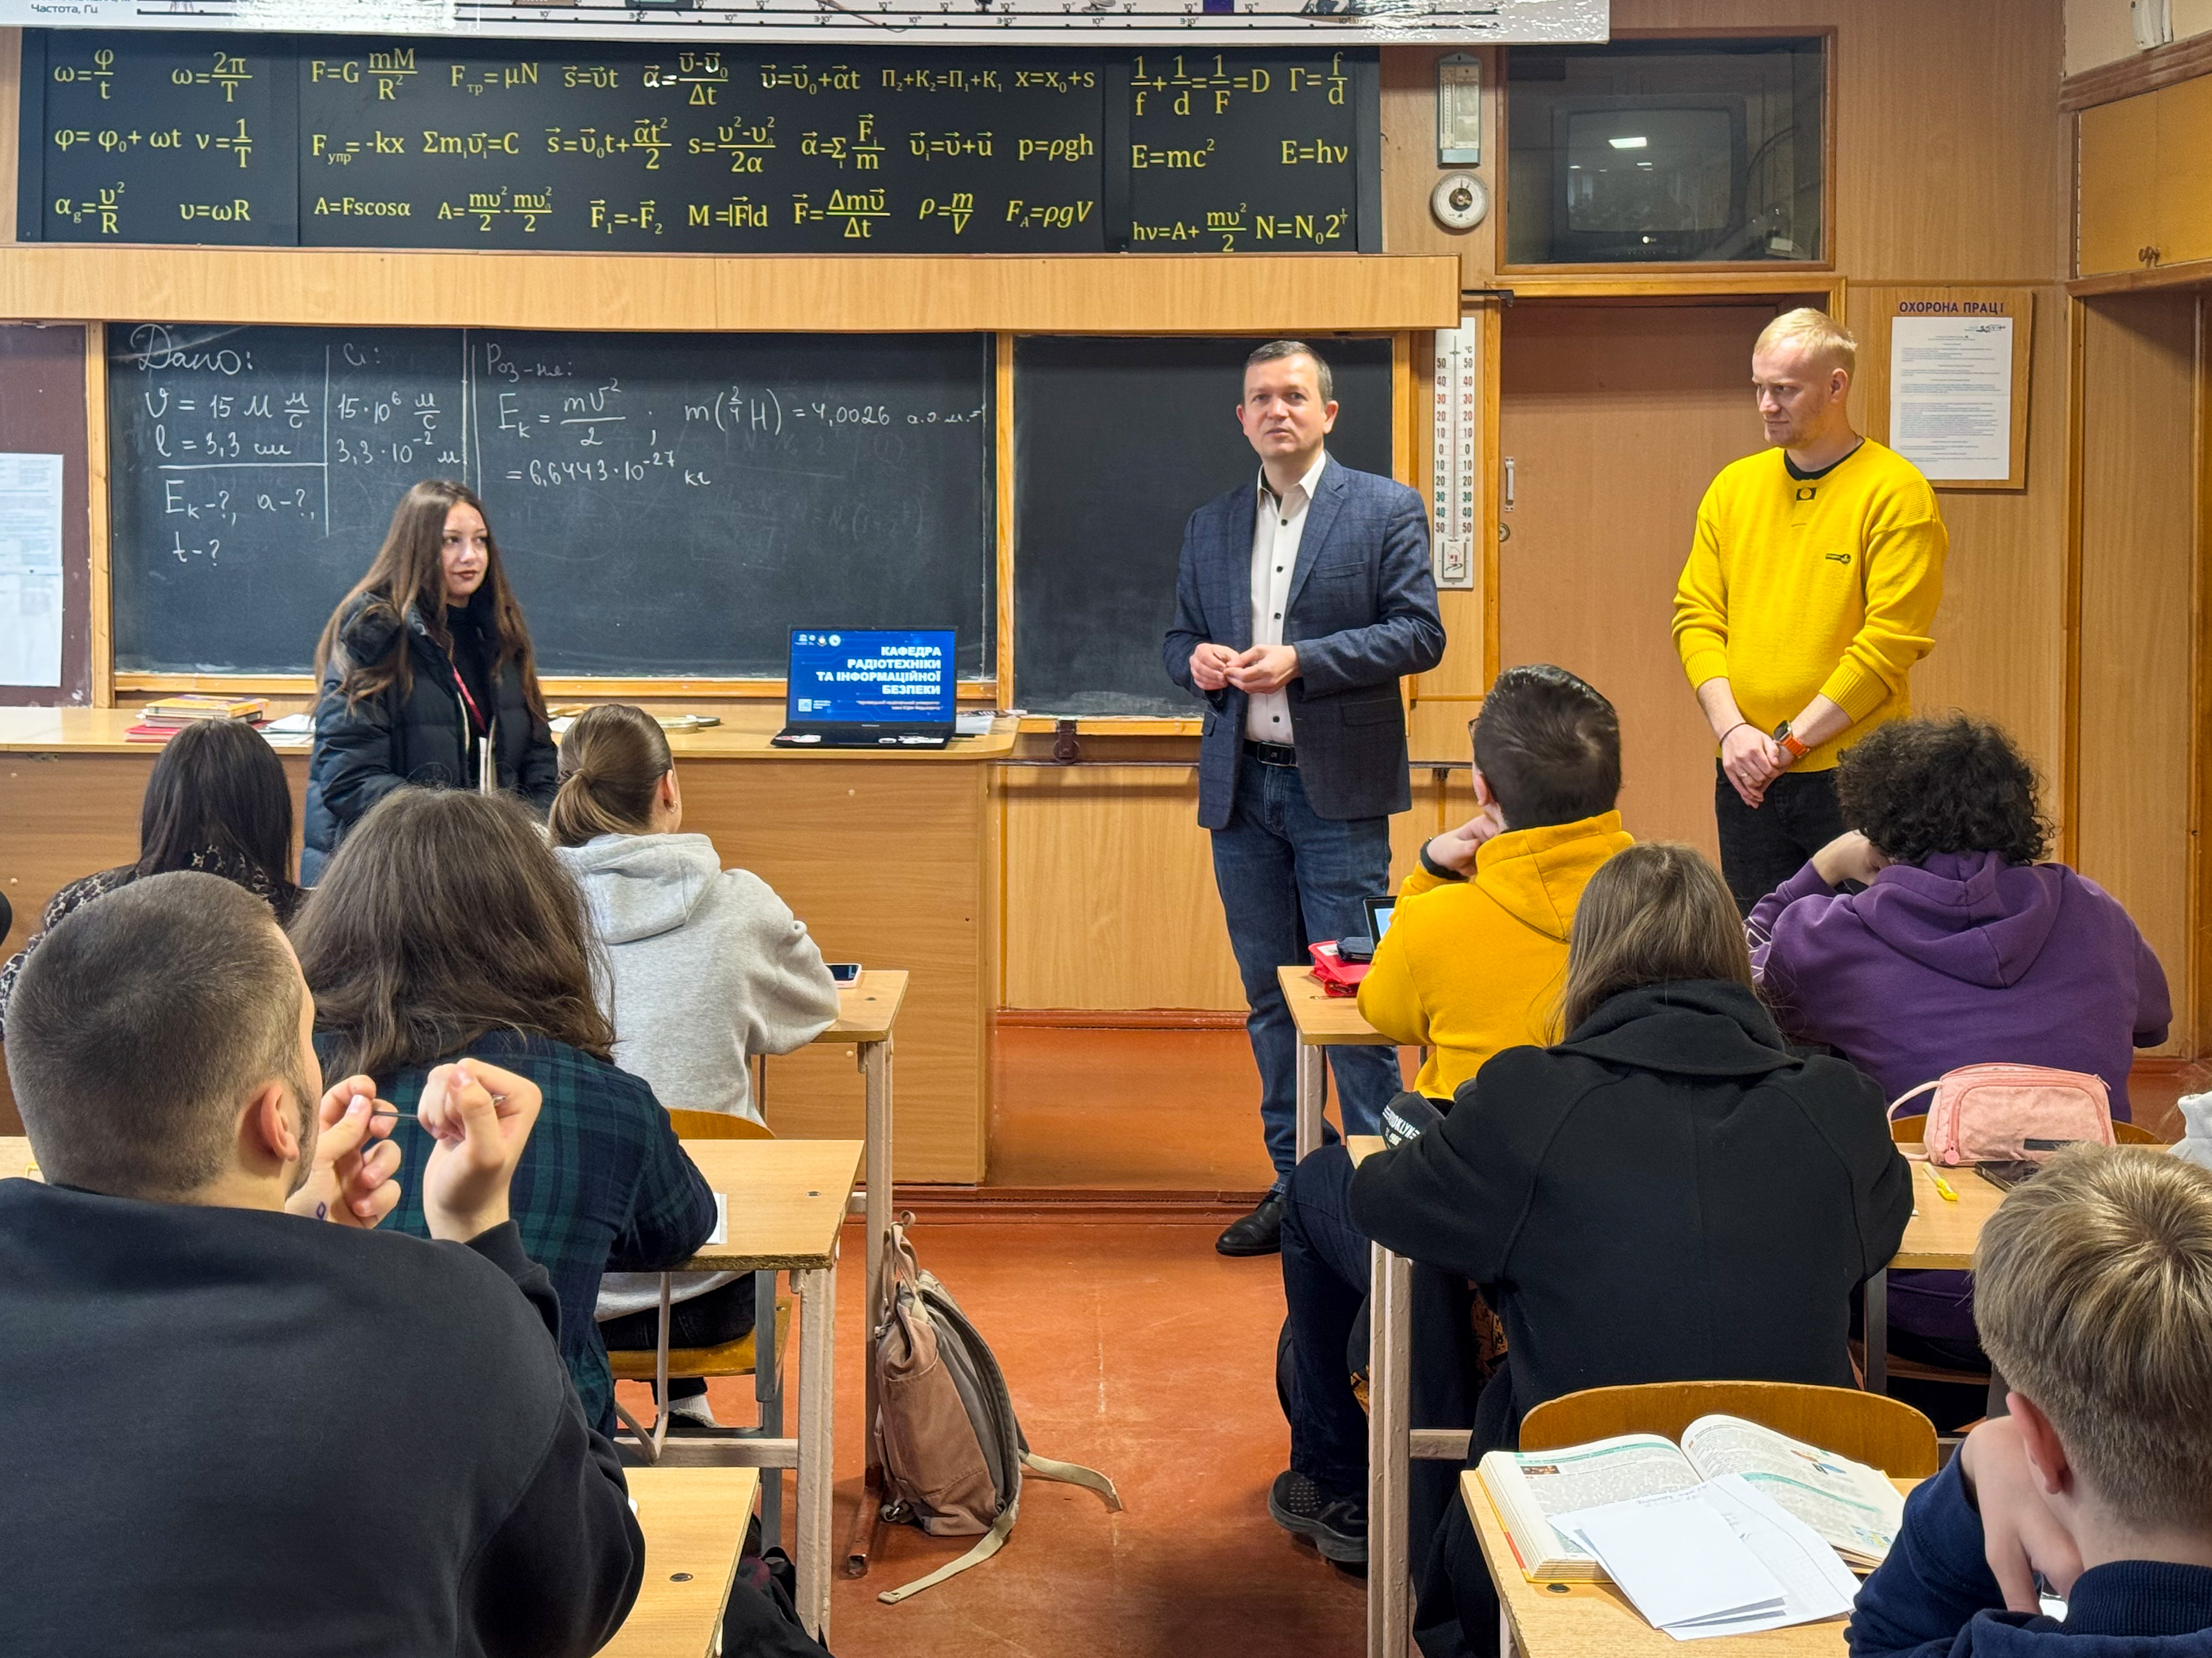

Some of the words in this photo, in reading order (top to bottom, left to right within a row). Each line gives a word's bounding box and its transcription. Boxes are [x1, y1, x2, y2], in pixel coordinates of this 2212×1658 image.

[31, 4, 81, 14] Частота,
[84, 4, 98, 14] Гц
[1899, 302, 1959, 313] ОХОРОНА
[1963, 302, 2004, 314] ПРАЦІ
[1436, 358, 1446, 369] 50
[1464, 358, 1473, 369] 50
[1437, 376, 1446, 387] 40
[1463, 376, 1472, 387] 40
[1436, 394, 1446, 404] 30
[1463, 394, 1472, 404] 30
[1436, 410, 1446, 422] 20
[1463, 410, 1472, 422] 20
[1437, 427, 1446, 438] 10
[1464, 427, 1472, 438] 10
[1438, 444, 1444, 455] 0
[1465, 444, 1470, 455] 0
[1436, 460, 1445, 471] 10
[1464, 460, 1472, 471] 10
[1436, 476, 1445, 486] 20
[1463, 476, 1472, 486] 20
[1436, 491, 1445, 502] 30
[1463, 491, 1472, 502] 30
[1436, 507, 1445, 518] 40
[1463, 507, 1472, 518] 40
[1436, 522, 1444, 533] 50
[1463, 522, 1471, 533] 50
[881, 647, 942, 658] КАФЕДРА
[848, 659, 941, 670] РАДІОТЕХНІКИ
[816, 671, 834, 682] ТА
[837, 671, 941, 683] ІНФОРМАЦІЙНОЇ
[882, 685, 940, 695] БЕЗПЕКИ
